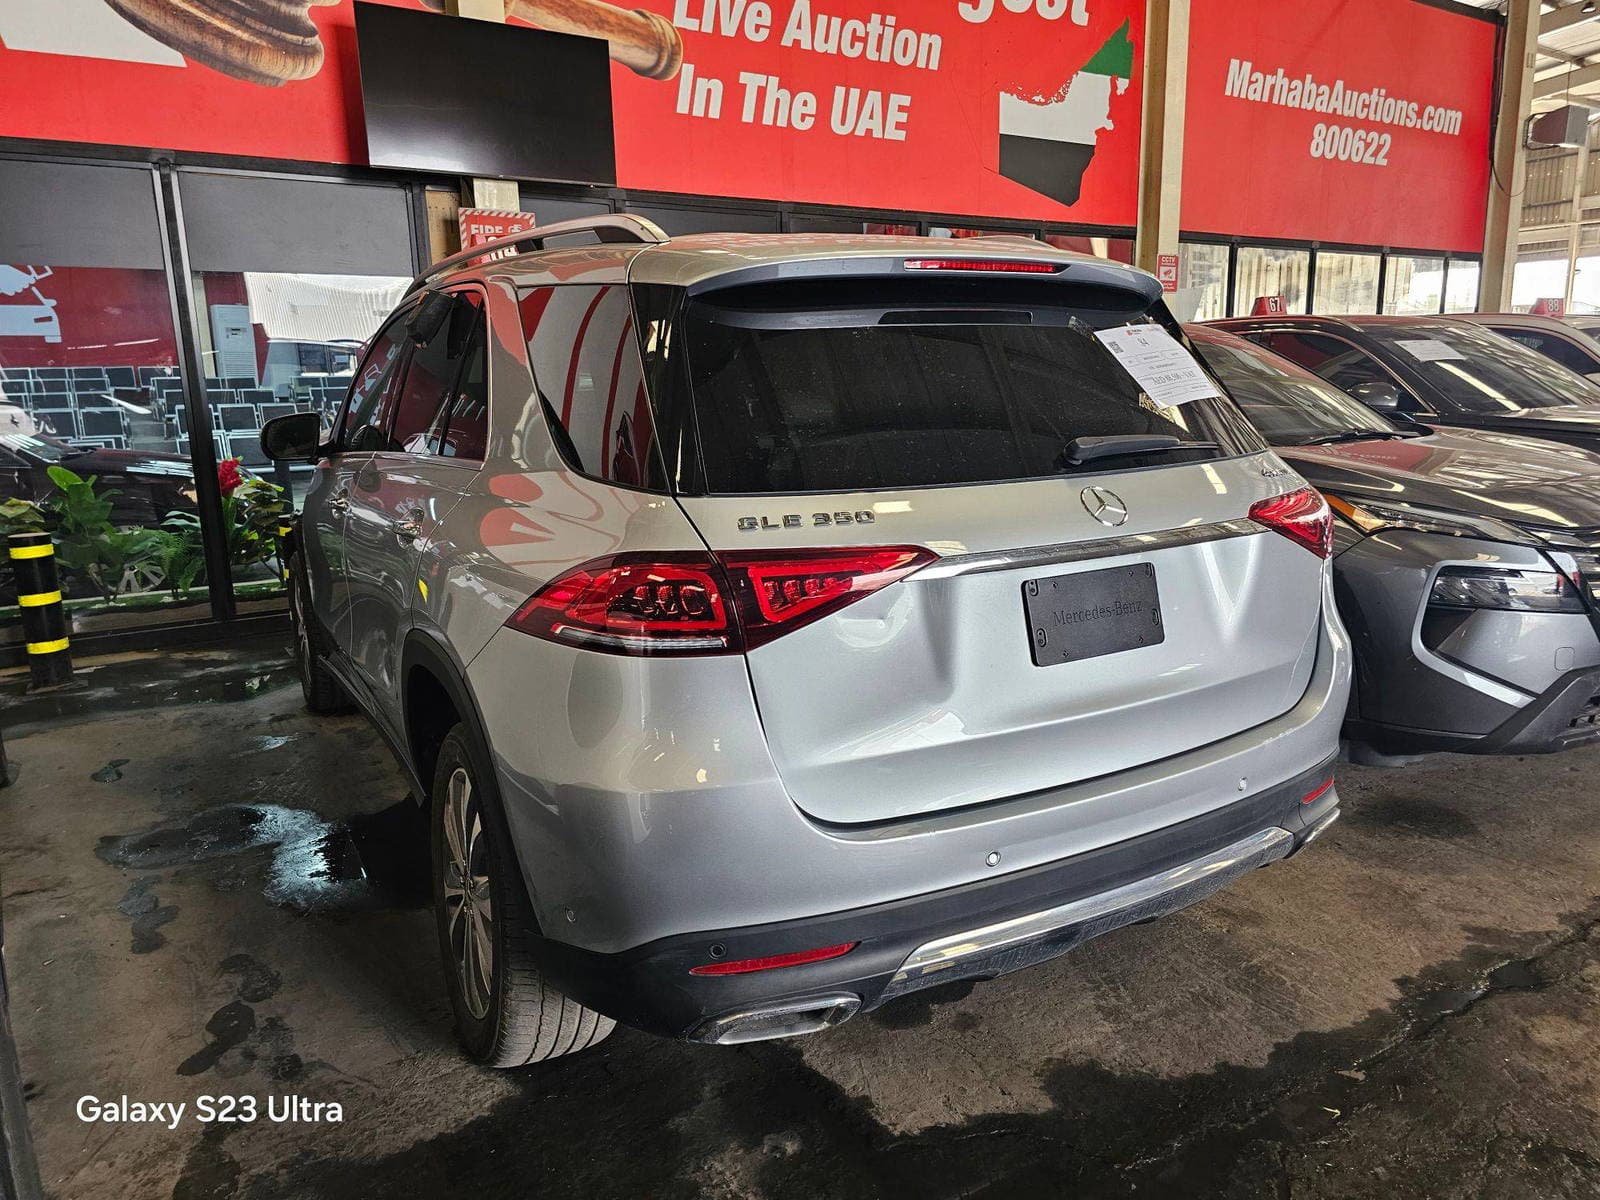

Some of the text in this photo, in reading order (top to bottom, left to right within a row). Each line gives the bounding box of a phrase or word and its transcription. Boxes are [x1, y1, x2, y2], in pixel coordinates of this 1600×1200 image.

[672, 0, 772, 43] Live
[780, 0, 942, 71] Auction
[675, 63, 912, 141] In The UAE
[1224, 58, 1463, 136] MarhabaAuctions.com
[1310, 123, 1392, 166] 800622
[1269, 297, 1281, 312] 67
[737, 510, 876, 530] GLE 350
[1053, 599, 1143, 626] Mercedes-Benz
